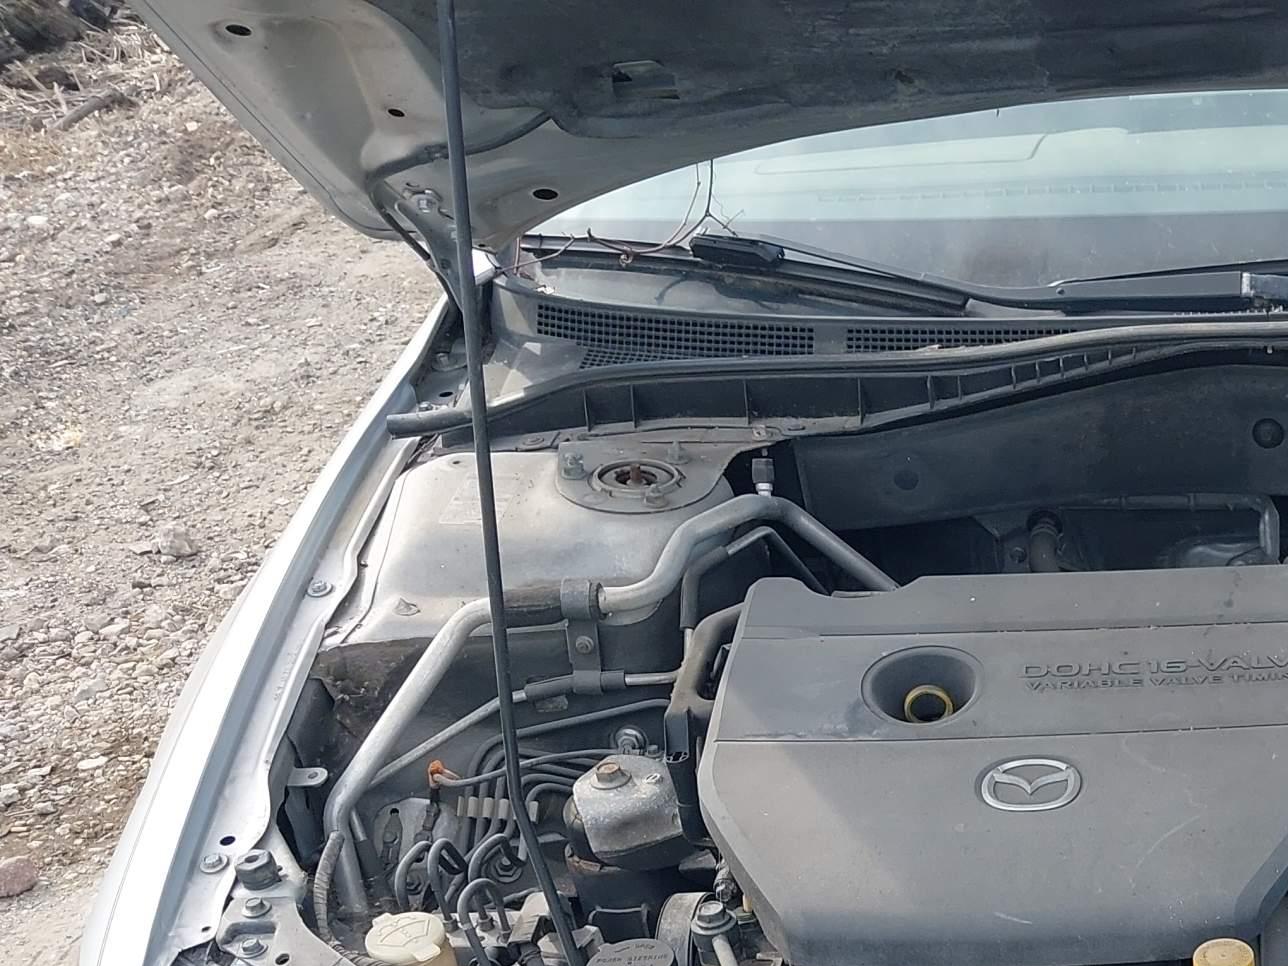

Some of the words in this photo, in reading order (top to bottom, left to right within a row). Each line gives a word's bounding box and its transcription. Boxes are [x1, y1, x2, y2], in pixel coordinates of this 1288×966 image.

[1022, 660, 1141, 679] DOHC
[1026, 678, 1144, 691] VARIABLE
[1149, 674, 1225, 687] VALVE
